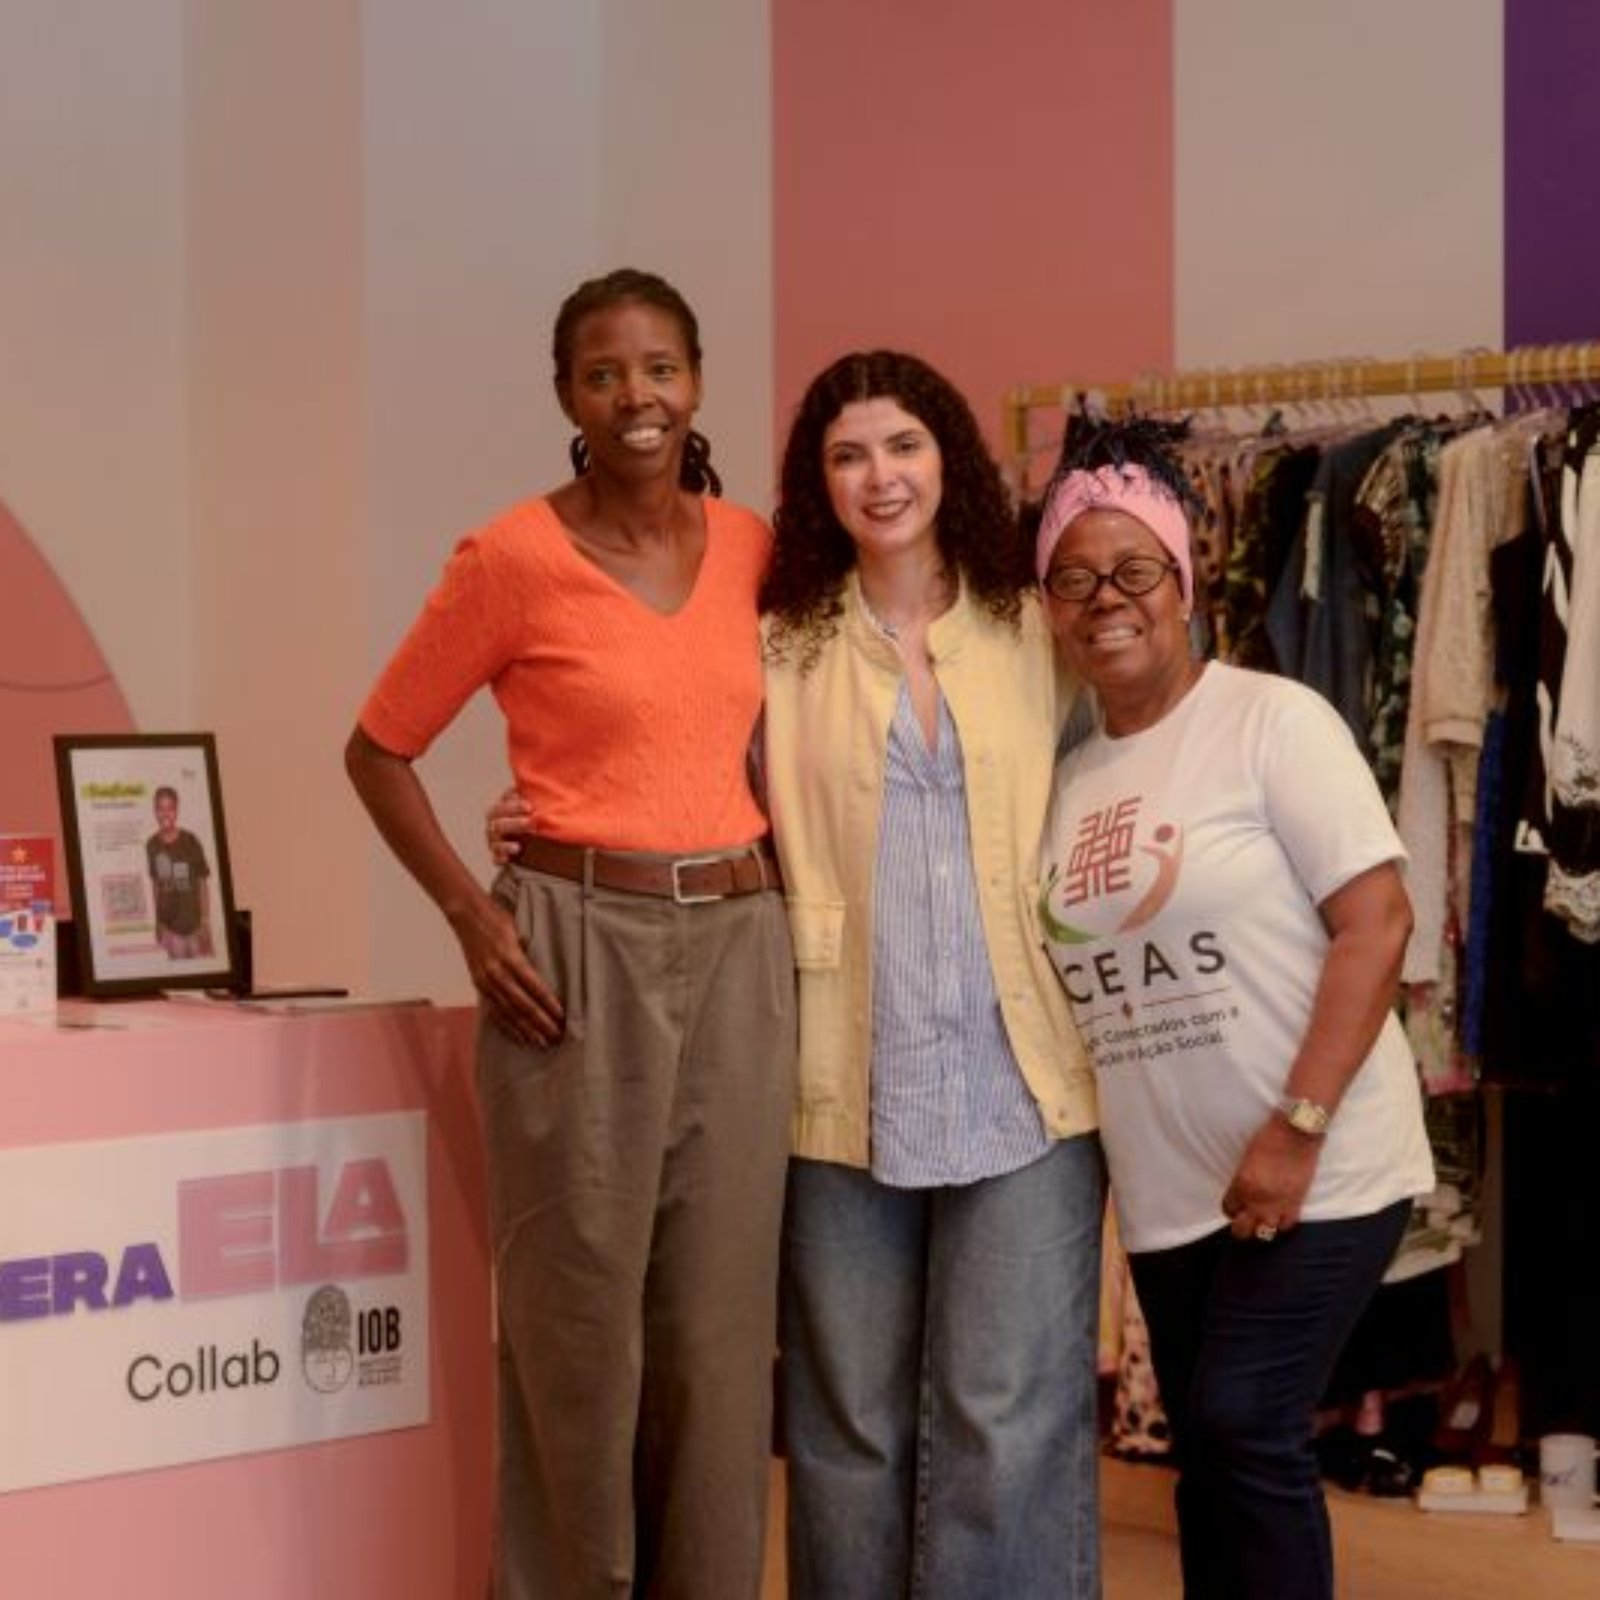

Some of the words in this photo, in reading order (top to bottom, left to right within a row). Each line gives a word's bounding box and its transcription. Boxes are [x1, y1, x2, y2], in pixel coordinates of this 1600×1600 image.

[0, 1242, 174, 1323] ERA
[177, 1157, 409, 1303] ELA
[358, 1305, 401, 1356] IOB
[127, 1339, 280, 1402] Collab
